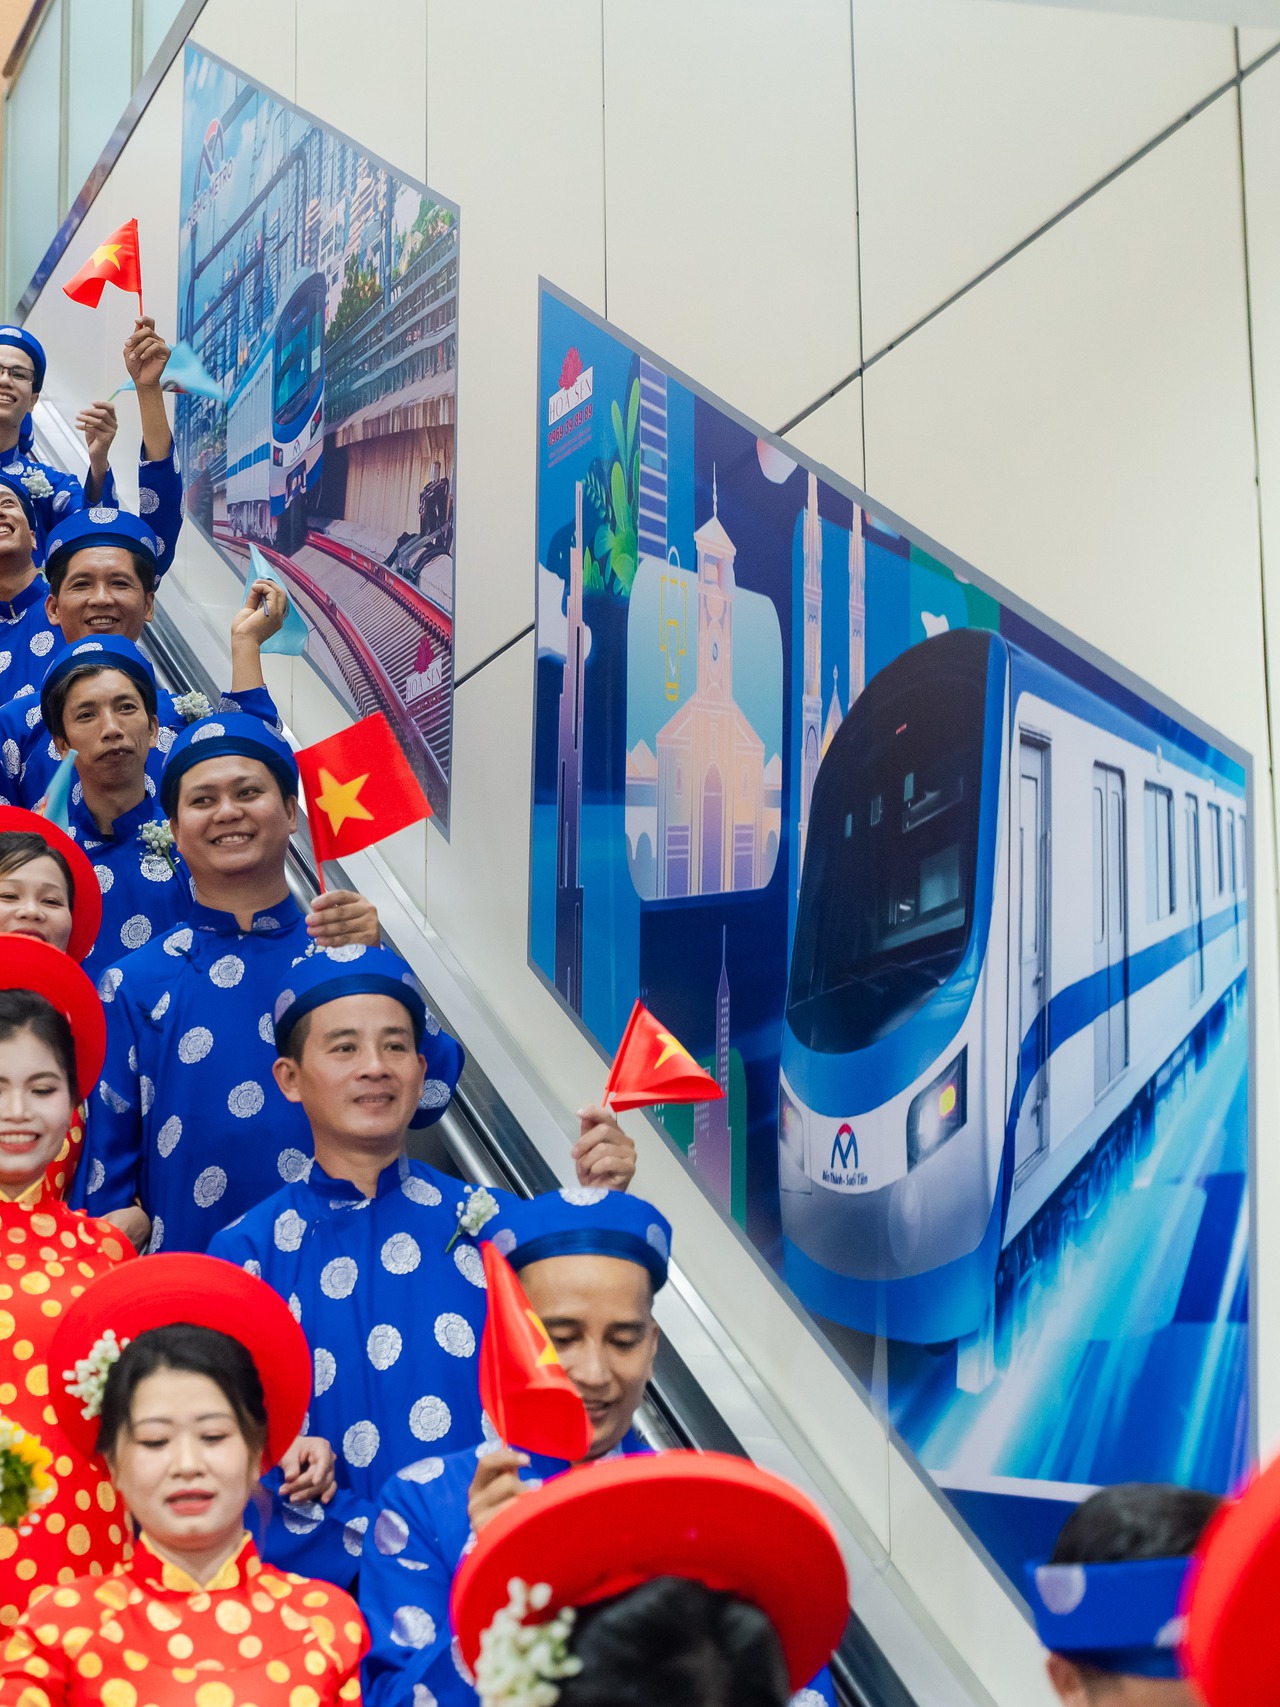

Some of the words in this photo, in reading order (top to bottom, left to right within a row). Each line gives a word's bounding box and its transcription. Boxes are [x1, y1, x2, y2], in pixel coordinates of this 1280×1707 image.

[209, 158, 233, 202] METRO
[549, 390, 571, 422] HOA
[575, 376, 592, 405] SEN
[547, 425, 564, 447] 0969
[565, 417, 573, 435] 39
[574, 410, 583, 428] 89
[584, 403, 593, 421] 89
[406, 677, 424, 699] HOA
[426, 663, 442, 689] SEN
